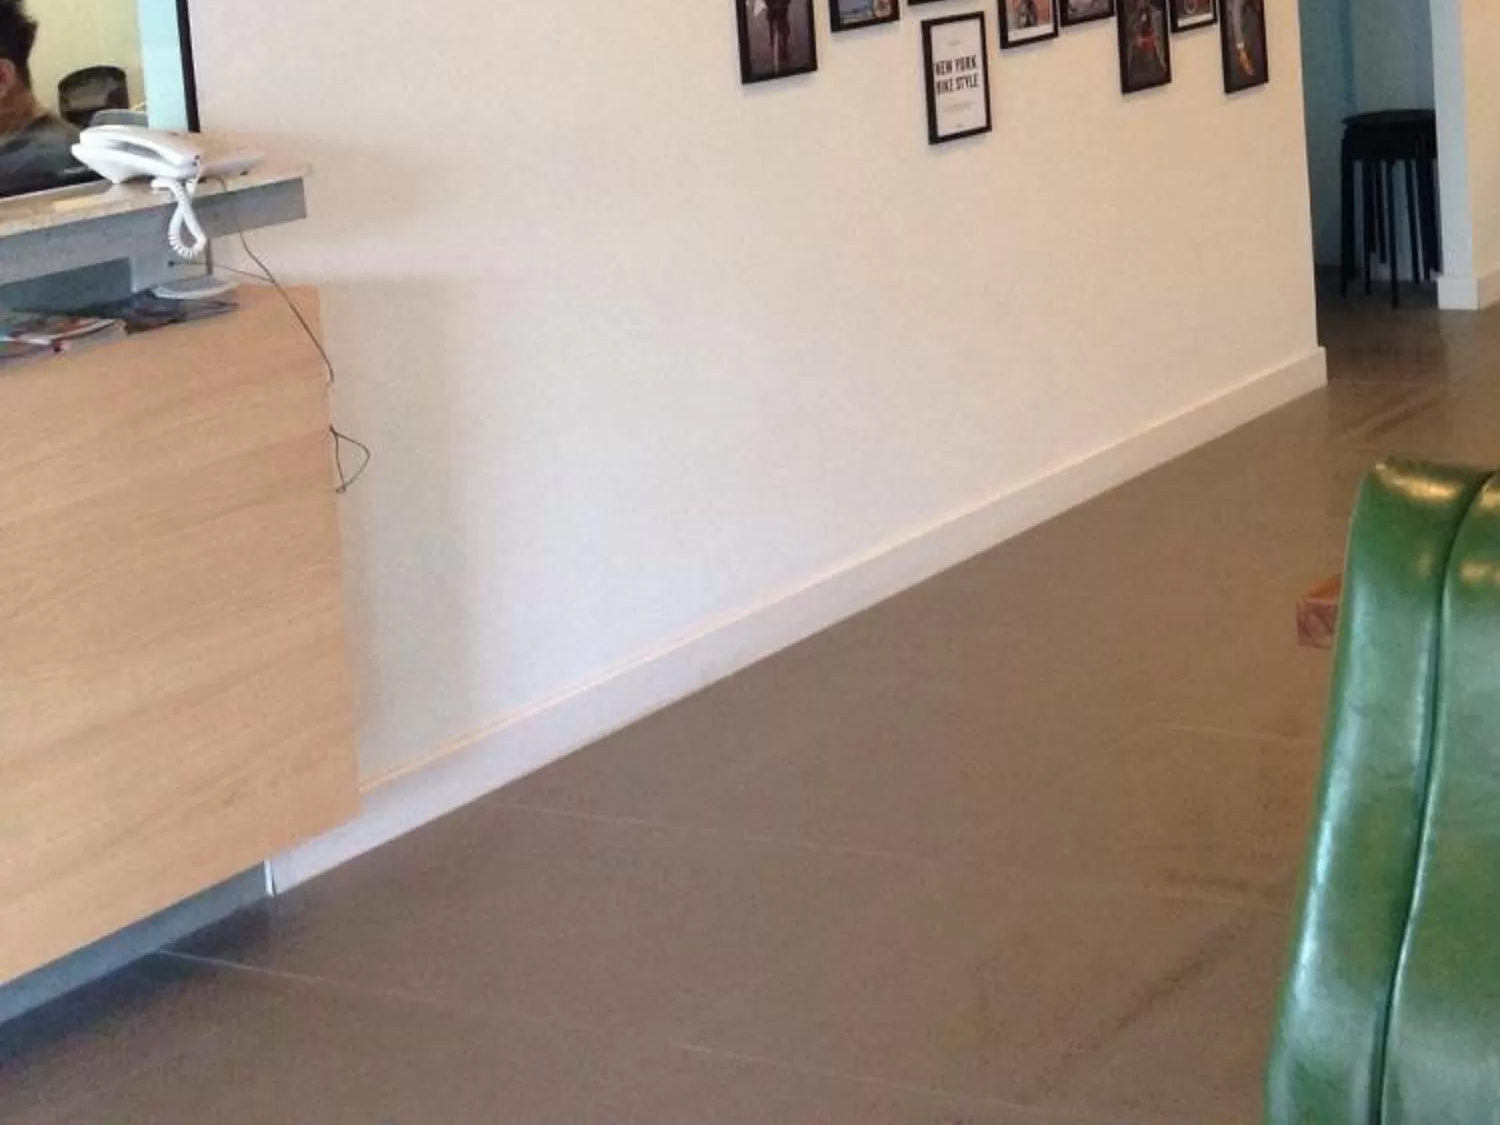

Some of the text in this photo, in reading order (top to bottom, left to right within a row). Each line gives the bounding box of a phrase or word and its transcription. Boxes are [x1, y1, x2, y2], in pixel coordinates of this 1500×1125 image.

[935, 55, 977, 75] NEW YORK
[955, 74, 979, 91] STYLE
